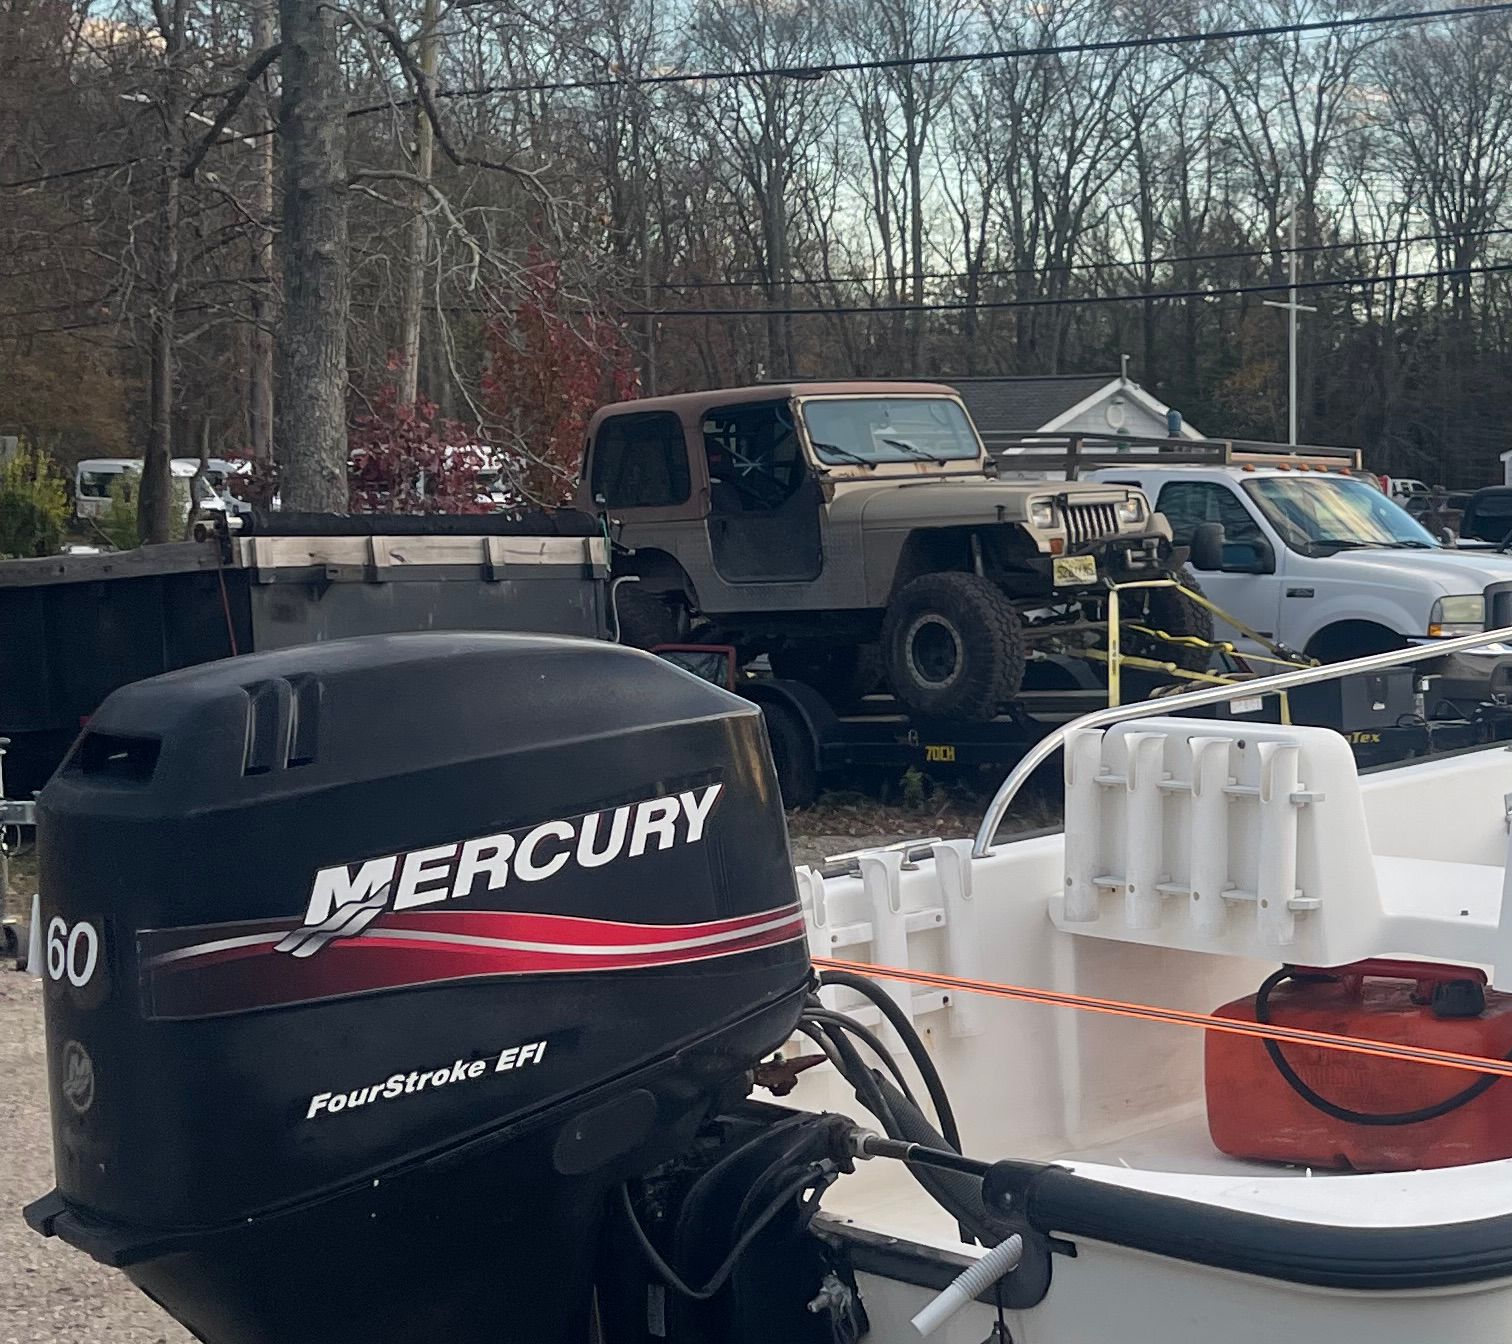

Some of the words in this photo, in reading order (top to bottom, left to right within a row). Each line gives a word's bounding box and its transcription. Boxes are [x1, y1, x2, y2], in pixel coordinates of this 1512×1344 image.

[303, 783, 722, 926] MERCURY
[47, 915, 98, 987] 60
[306, 1058, 487, 1119] FourStroke
[494, 1040, 548, 1073] EFI
